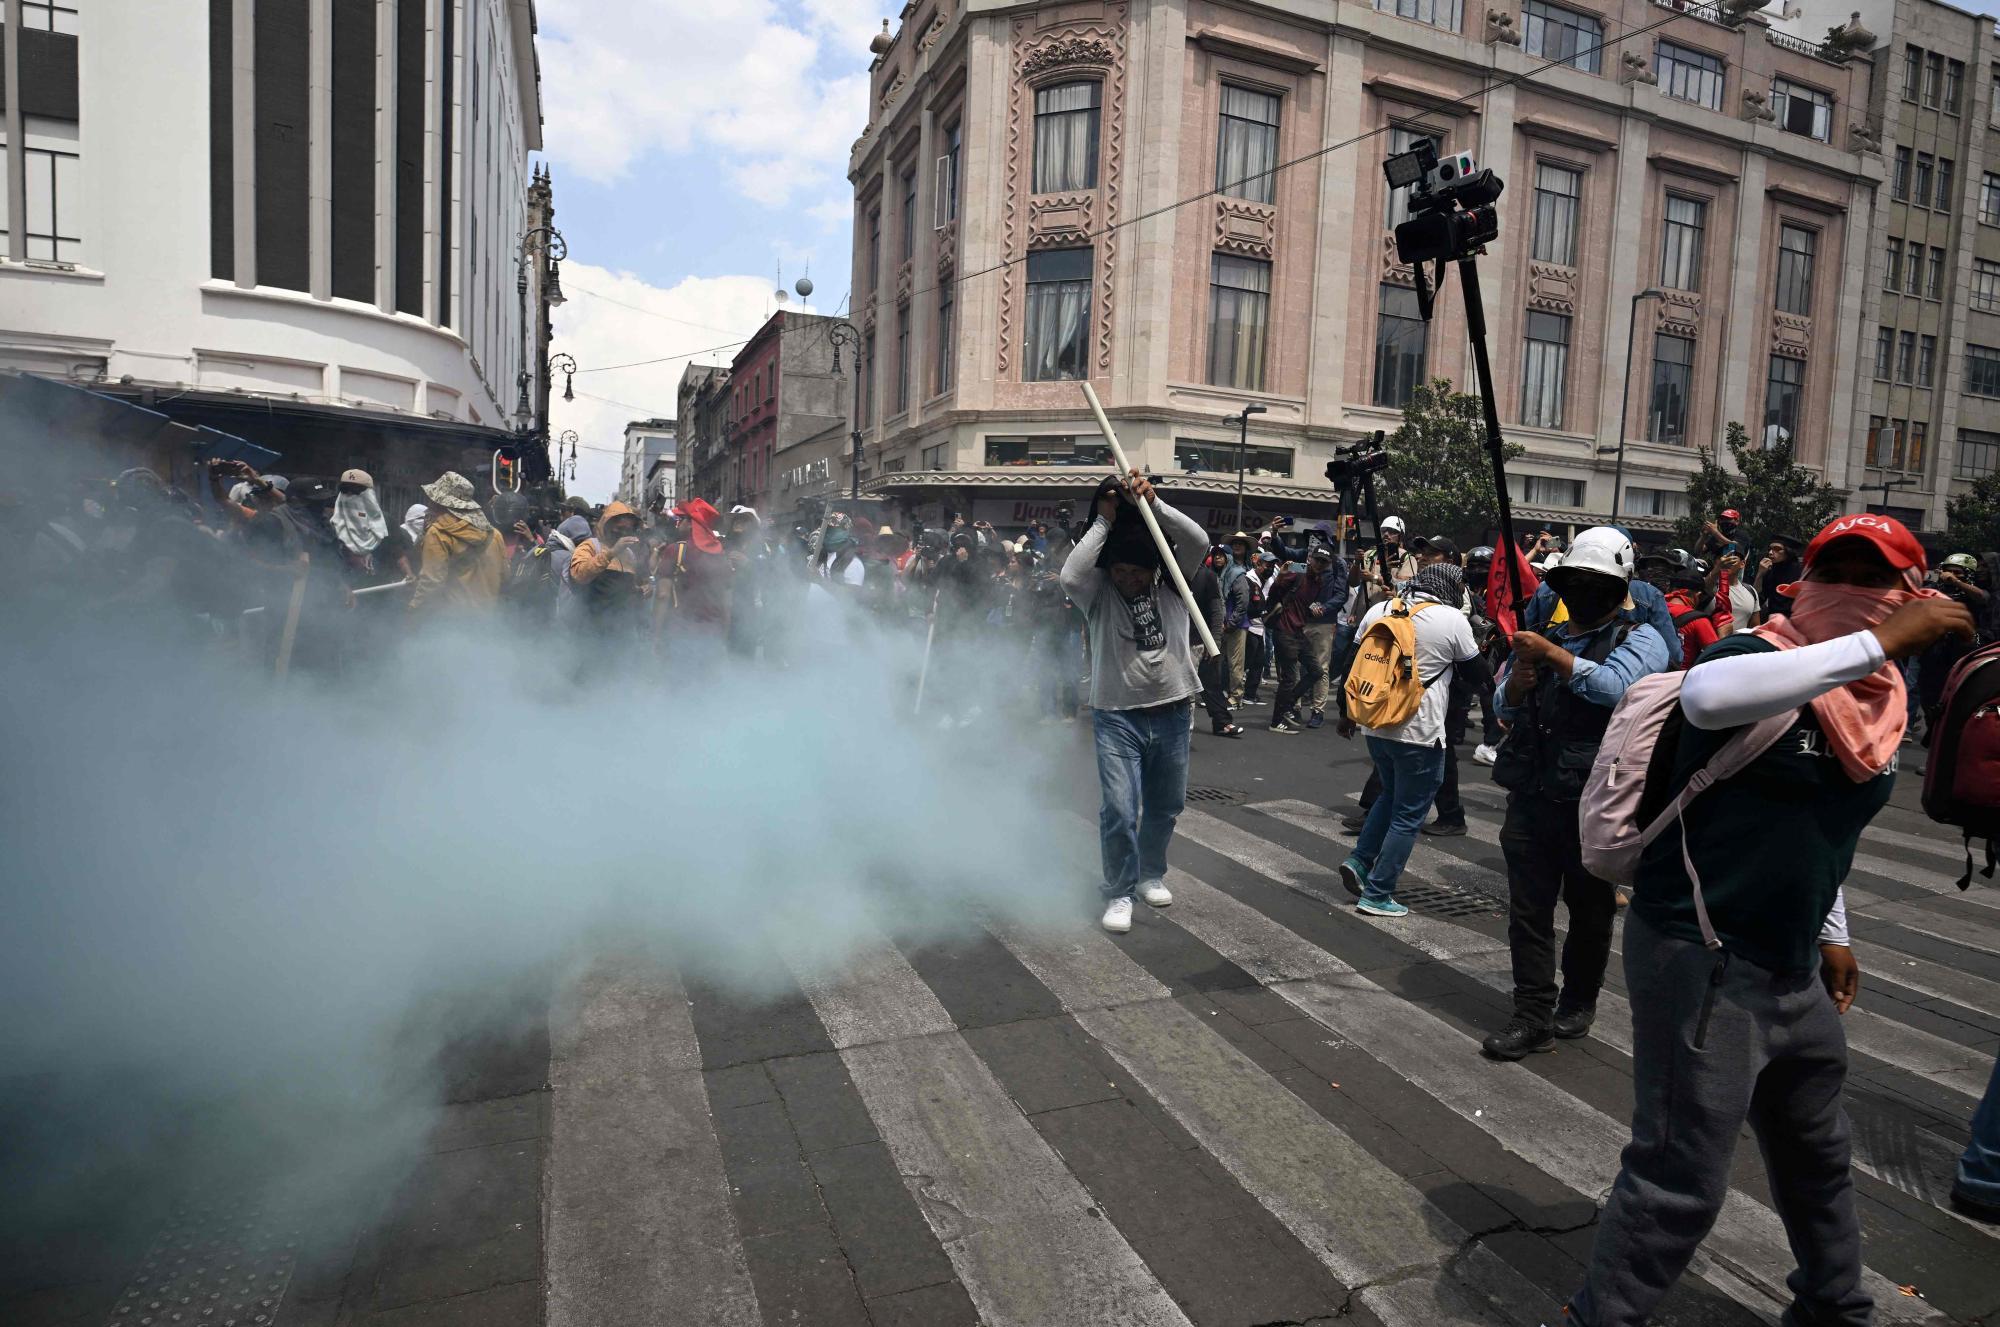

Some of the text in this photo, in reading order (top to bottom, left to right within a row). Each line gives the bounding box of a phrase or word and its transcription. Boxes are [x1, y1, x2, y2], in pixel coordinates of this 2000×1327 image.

[1829, 517, 1892, 534] AJGA
[1145, 625, 1157, 636] LA
[1364, 652, 1391, 665] adidas
